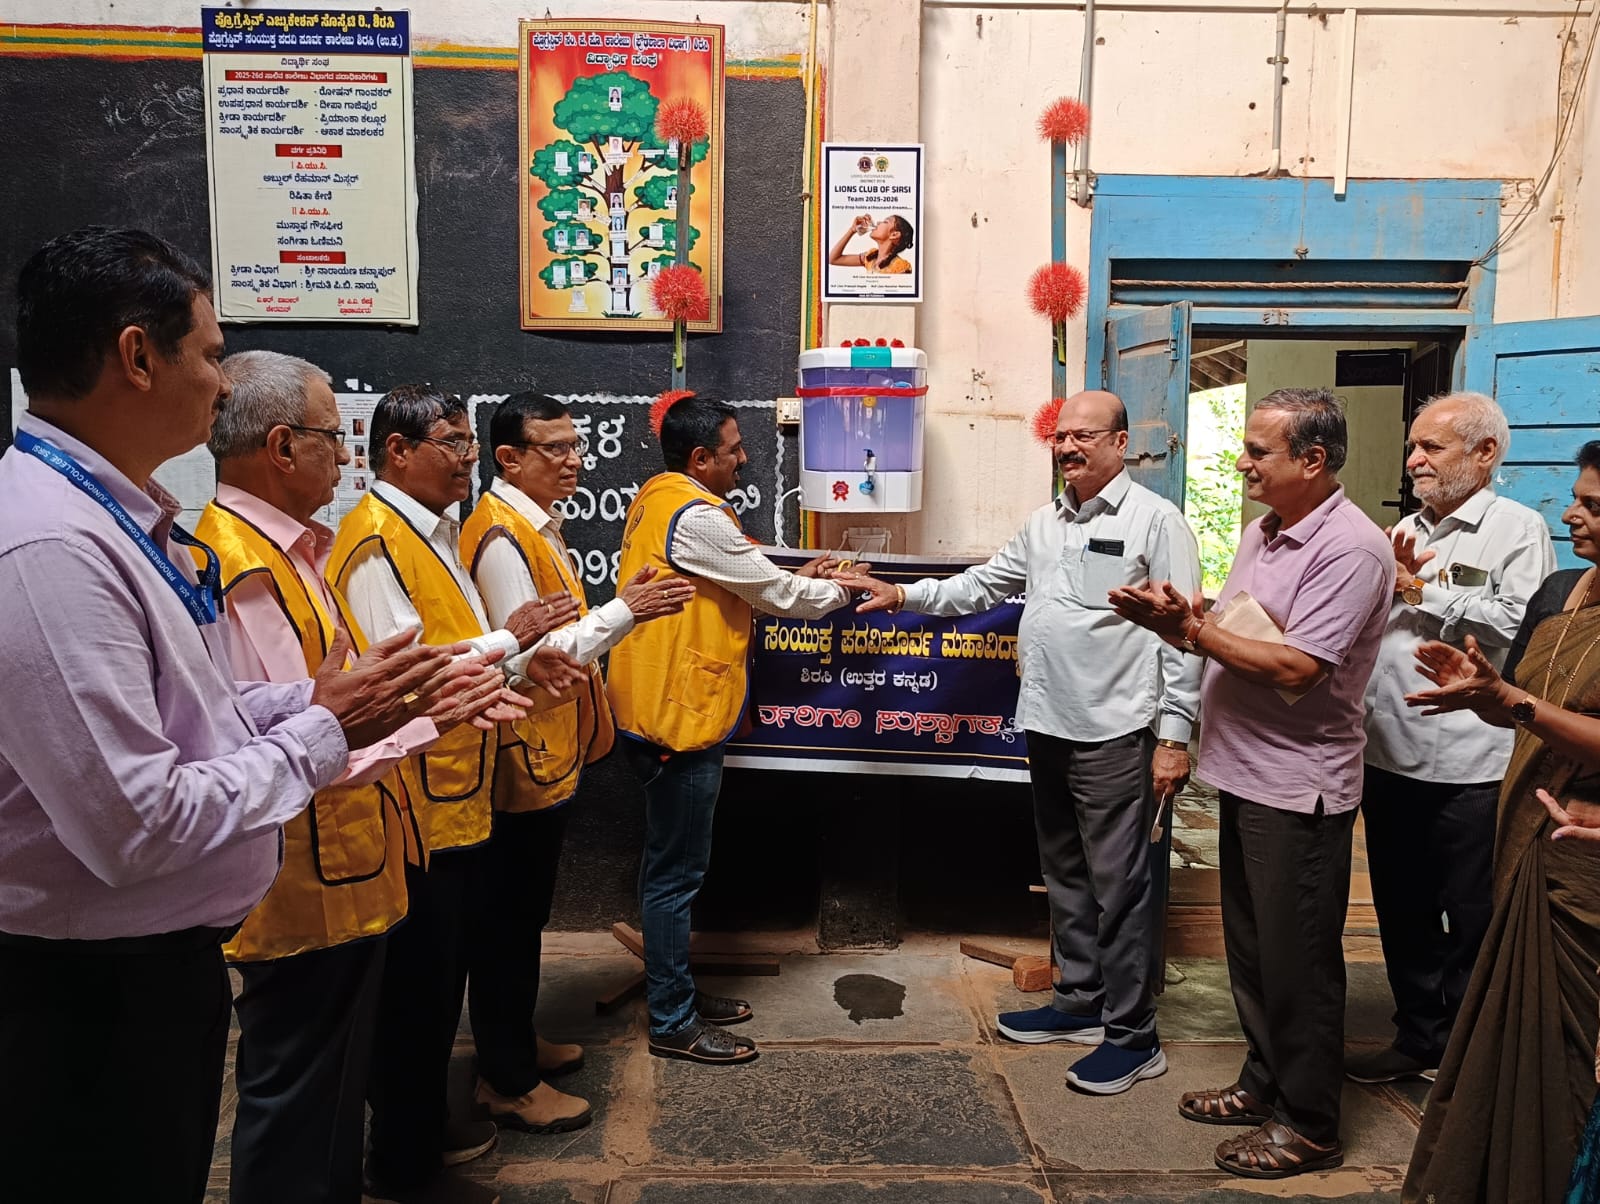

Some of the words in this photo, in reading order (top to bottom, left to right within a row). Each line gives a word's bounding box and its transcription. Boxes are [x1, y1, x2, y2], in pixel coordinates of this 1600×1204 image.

[372, 14, 395, 28] ಶಿರಸಿ
[245, 33, 276, 48] ಸಂಯುಕ್ತ
[279, 33, 297, 45] ಪದವಿ
[299, 34, 322, 45] ಪೂರ್ವ
[357, 34, 374, 46] ಶಿರಸಿ
[586, 53, 628, 69] ವಿದ್ಯಾರ್ಥಿ
[632, 53, 657, 66] ಸಂಘ
[218, 85, 244, 98] ಪ್ರಧಾನ
[246, 86, 290, 96] ಕಾರ್ಯದರ್ಶಿ
[218, 100, 263, 111] ಉಪಪ್ರಧಾನ
[265, 100, 309, 109] ಕಾರ್ಯದರ್ಶಿ
[242, 114, 287, 122] ಕಾರ್ಯದರ್ಶಿ
[260, 127, 305, 136] ಕಾರ್ಯದರ್ಶಿ
[834, 185, 857, 193] LIONS
[858, 185, 878, 193] CLUB
[254, 265, 279, 274] ವಿಭಾಗ
[272, 280, 298, 289] ವಿಭಾಗ
[32, 444, 51, 459] SIRSI
[82, 479, 109, 504] JUNIOR
[105, 501, 141, 537] COMPOSITE
[139, 537, 176, 582] PROGRESSIVE
[764, 619, 834, 665] ಸಂಯುಕ್ತ
[841, 621, 934, 658] ಪದವಿಪೂರ್ವ
[800, 667, 833, 684] ಶಿರಸಿ
[840, 667, 887, 691] (ಉತ್ತರ
[893, 670, 939, 694] ಕನ್ನಡ)
[875, 709, 1003, 743] ಸುಸ್ವಾಗತ
